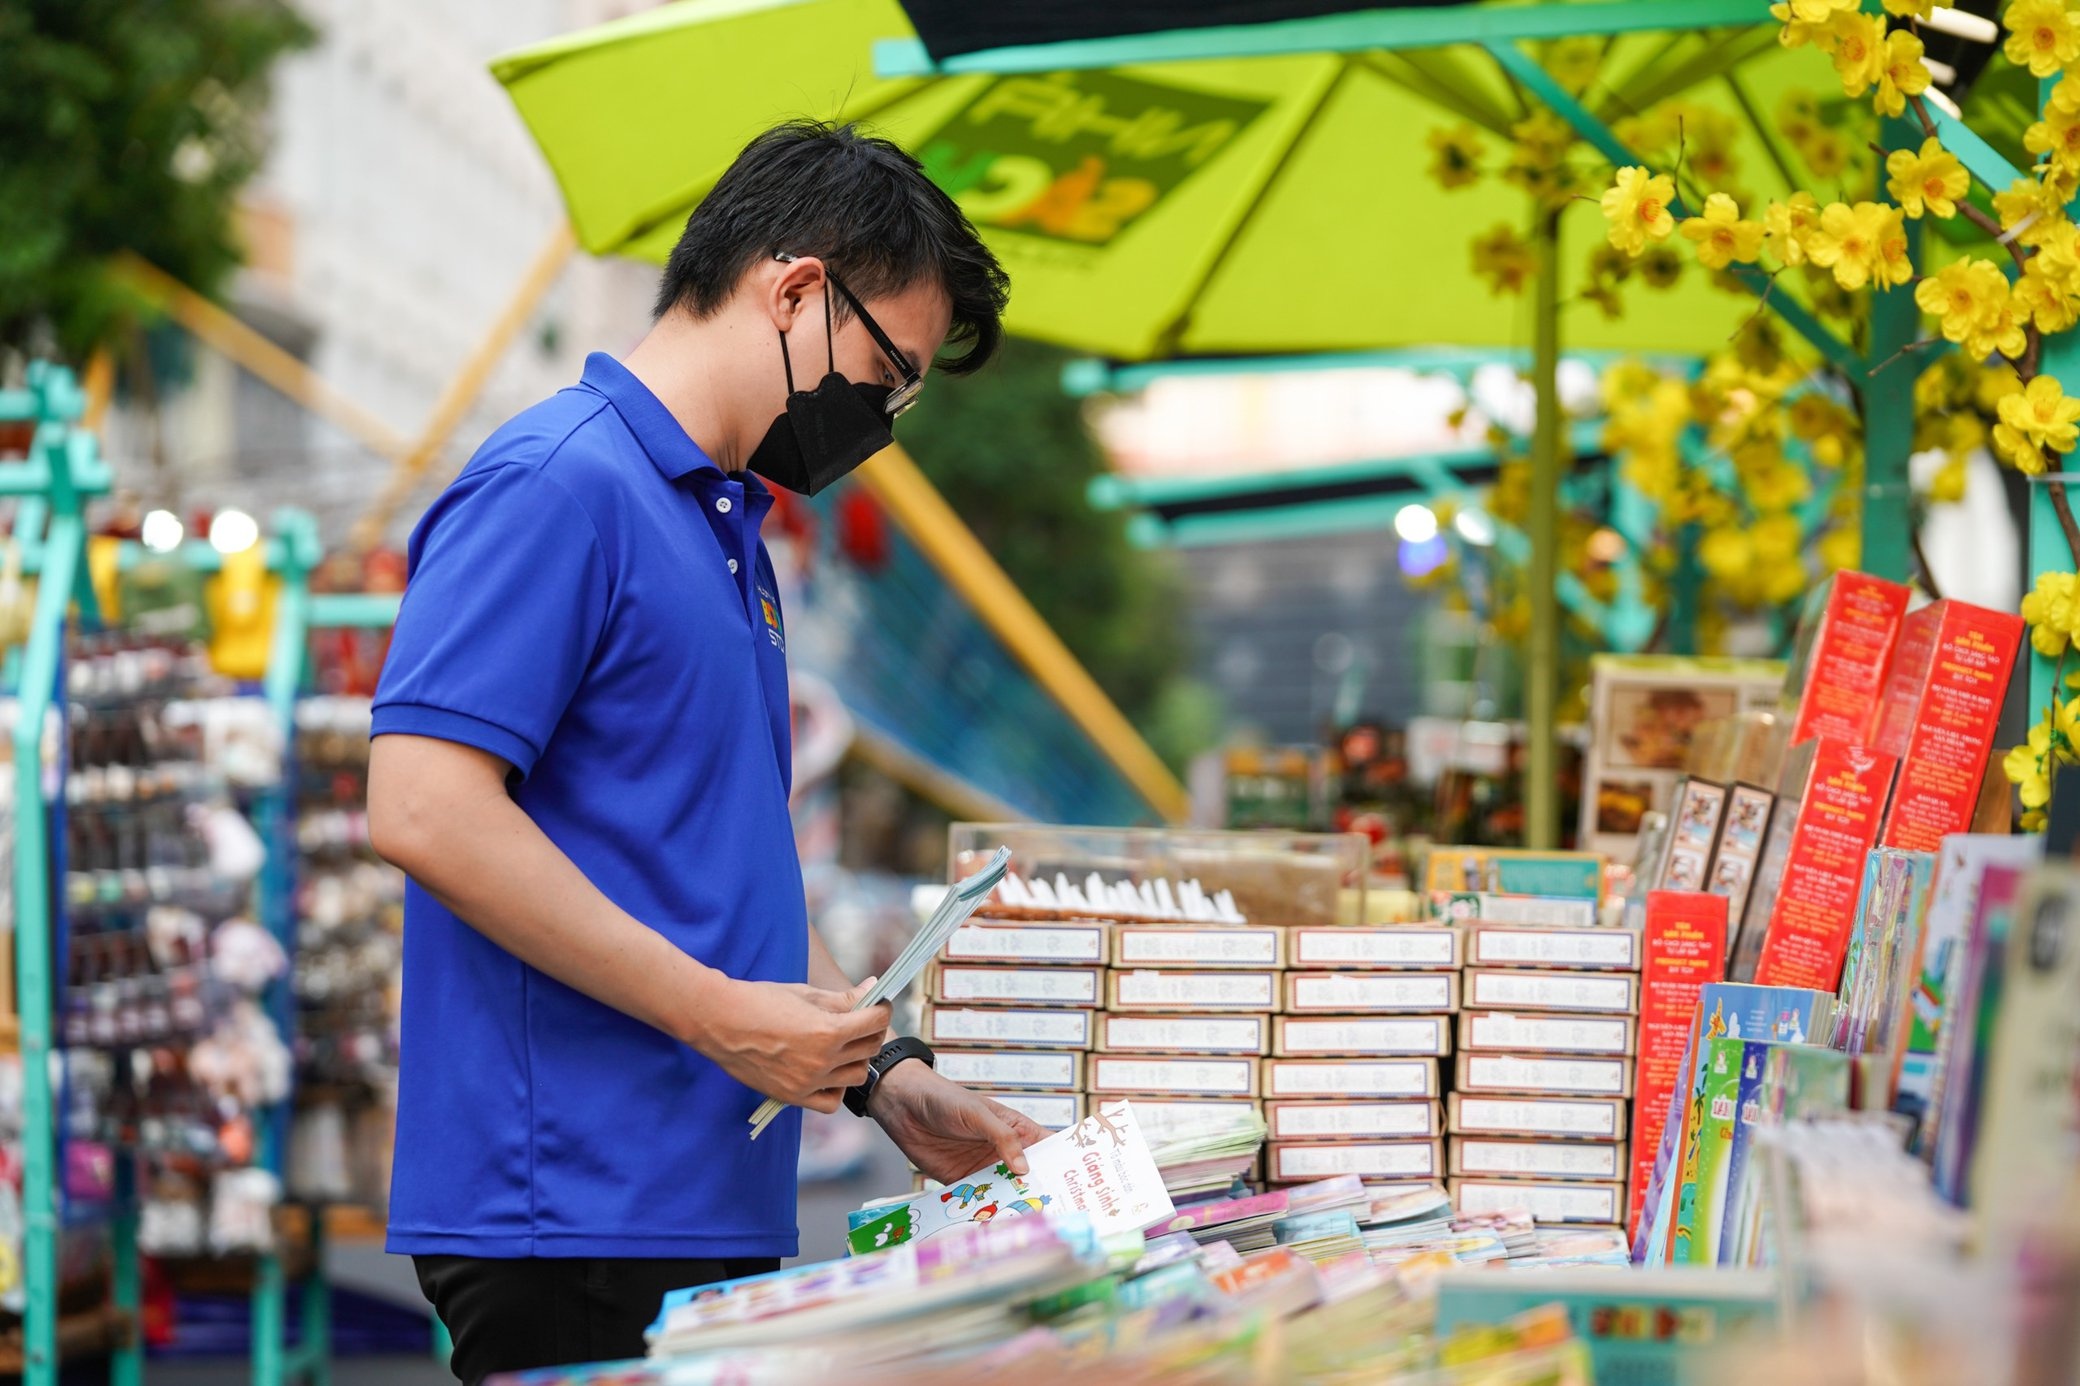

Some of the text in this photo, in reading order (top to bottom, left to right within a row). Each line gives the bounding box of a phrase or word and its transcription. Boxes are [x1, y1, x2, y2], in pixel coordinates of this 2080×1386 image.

[1064, 1170, 1090, 1212] Christma
[1082, 1152, 1120, 1211] Giáng sinh
